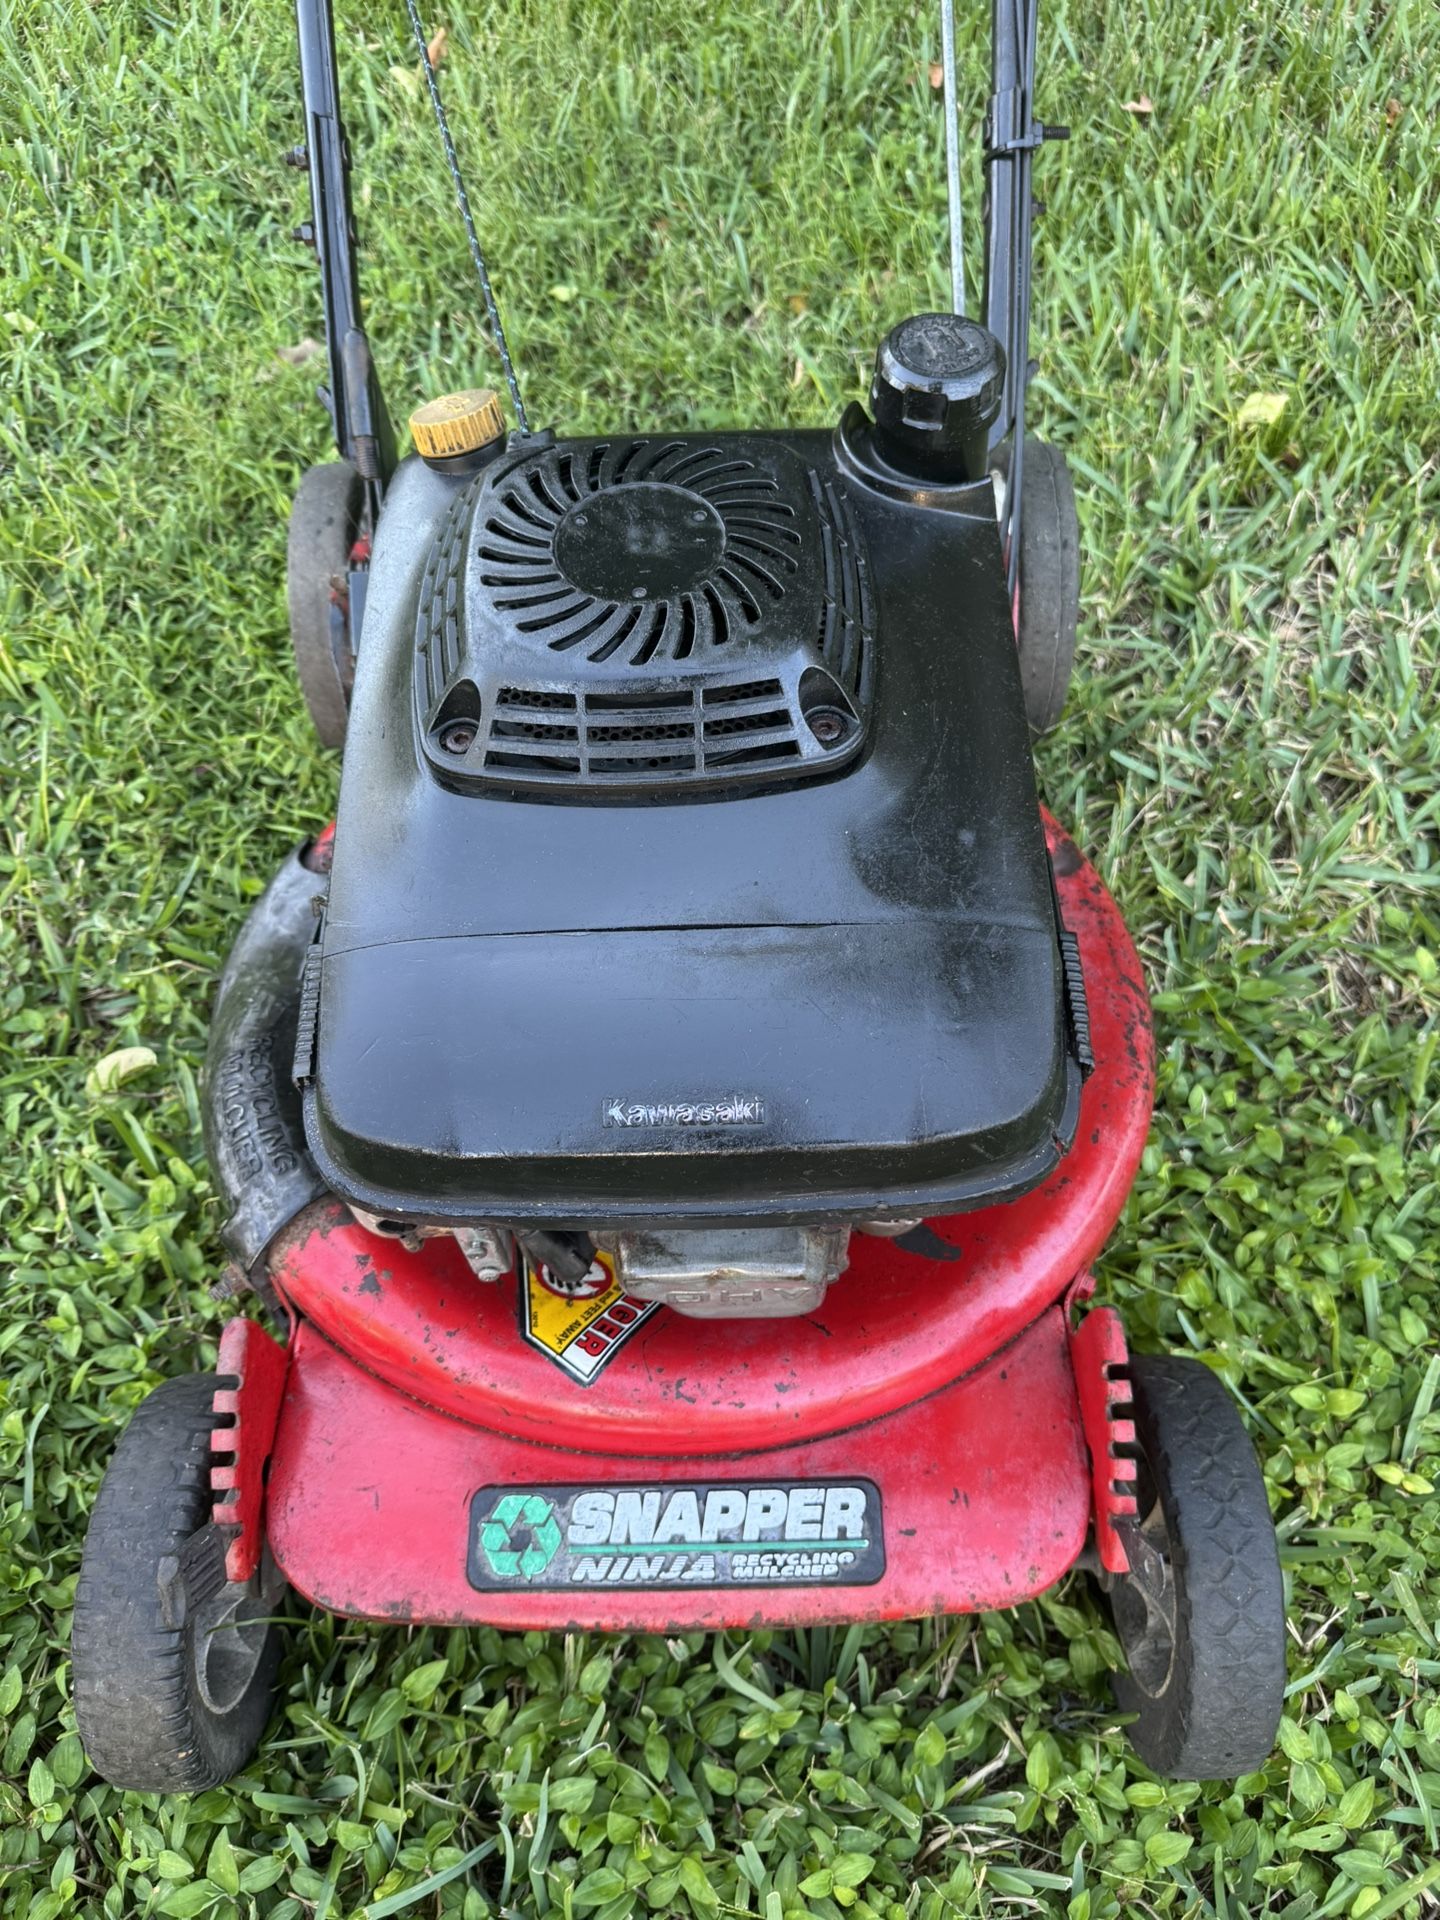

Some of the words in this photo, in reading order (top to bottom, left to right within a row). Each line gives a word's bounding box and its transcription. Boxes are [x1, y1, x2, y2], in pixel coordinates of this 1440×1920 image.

[249, 1035, 298, 1175] RECYCLING
[602, 1096, 764, 1127] Kawasaki
[580, 1302, 603, 1321] FEET
[567, 1487, 866, 1544] SNAPPER
[571, 1555, 716, 1581] NINJA
[732, 1551, 855, 1567] RECYCLING
